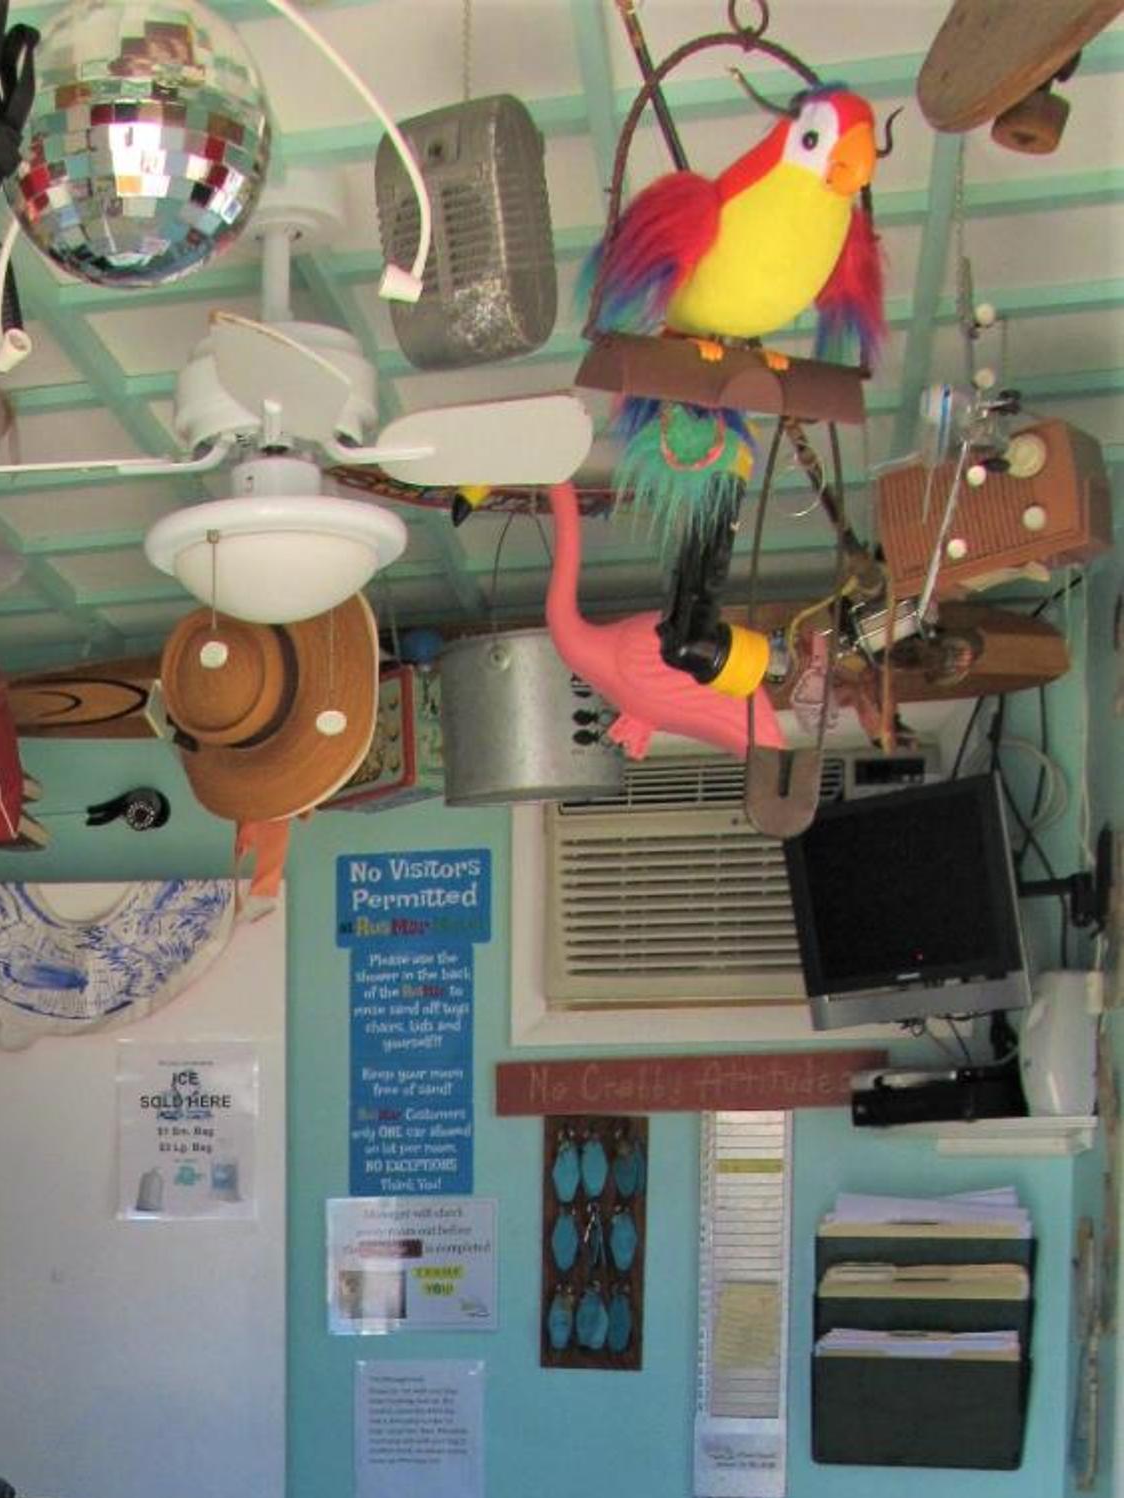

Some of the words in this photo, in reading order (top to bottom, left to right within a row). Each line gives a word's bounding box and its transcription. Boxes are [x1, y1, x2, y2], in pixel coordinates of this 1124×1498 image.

[349, 861, 382, 883] No
[389, 858, 480, 881] Visitors
[352, 881, 478, 911] Permitted
[171, 1072, 199, 1086] ICE
[140, 1094, 183, 1109] SOLD
[188, 1094, 231, 1109] HERE
[378, 1124, 404, 1138] ONE
